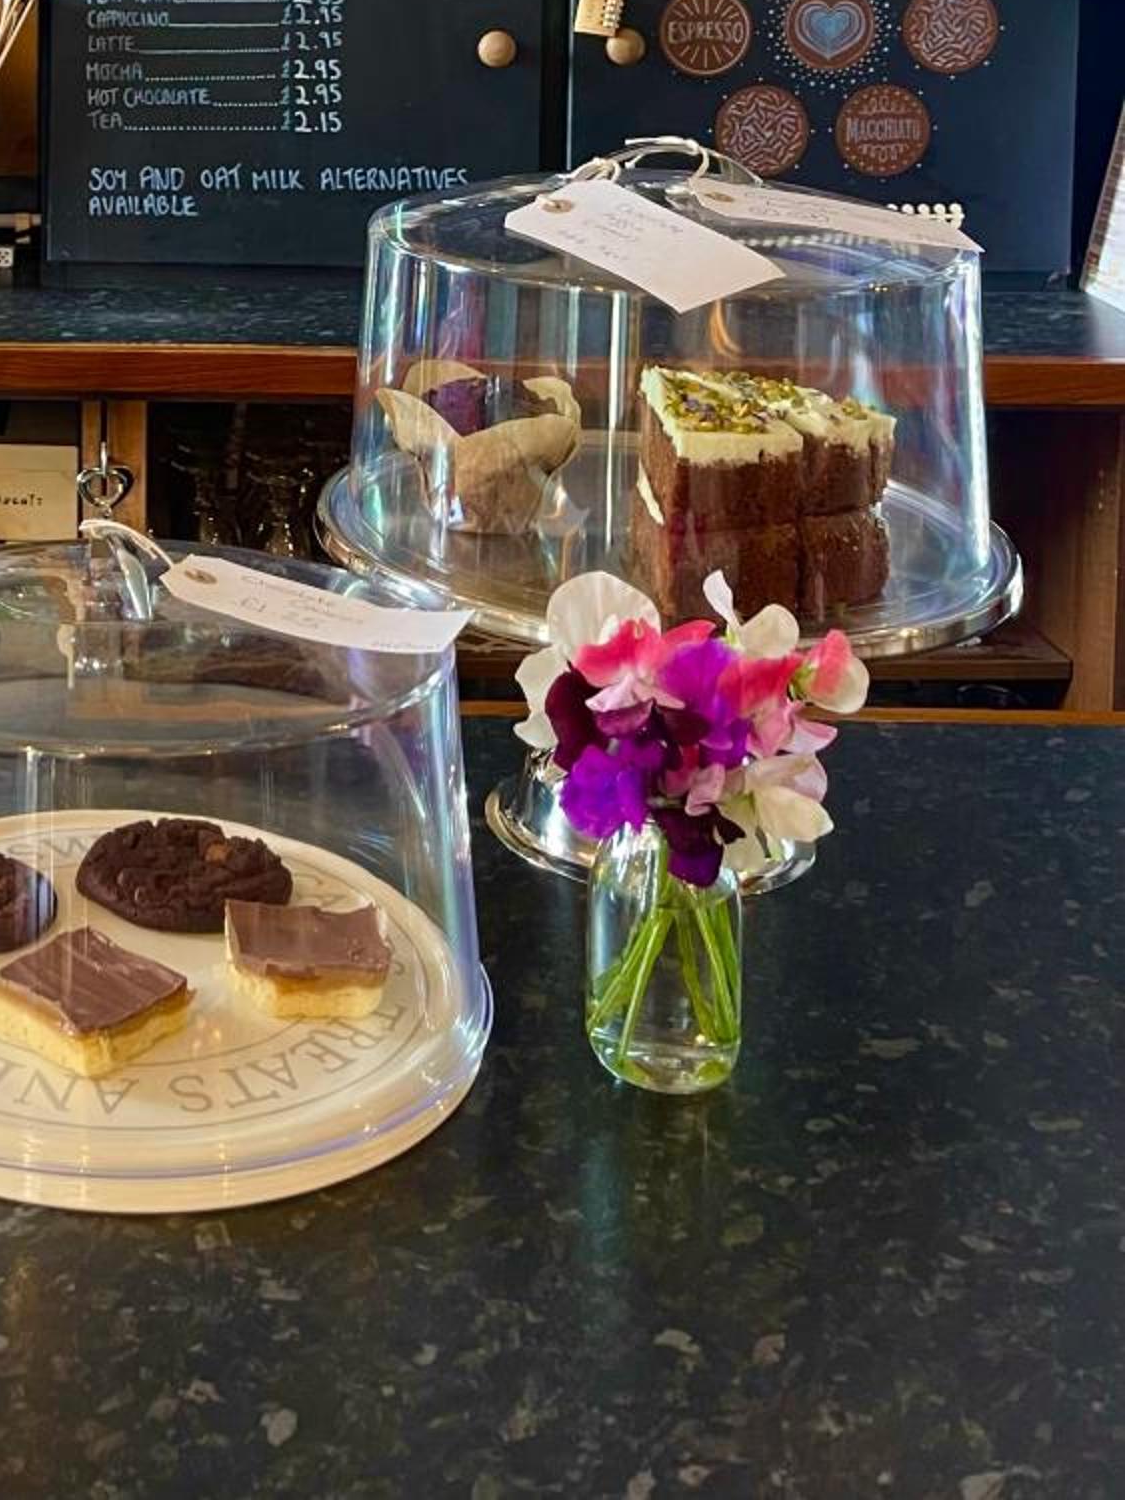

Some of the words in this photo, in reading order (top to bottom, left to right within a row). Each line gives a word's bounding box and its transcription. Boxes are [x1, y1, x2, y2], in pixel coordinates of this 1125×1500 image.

[667, 19, 745, 45] ESPRESSO
[87, 35, 135, 52] LATTE
[86, 63, 143, 81] MOCHA
[87, 87, 119, 106] HOT
[87, 109, 123, 130] TEA
[88, 168, 130, 191] SOY
[139, 167, 184, 191] AND
[201, 164, 241, 191] OAT
[252, 166, 305, 191] MILK
[320, 166, 468, 191] ALTERNATIVES
[88, 194, 199, 217] AVAILABLE
[171, 1004, 406, 1113] TREATS
